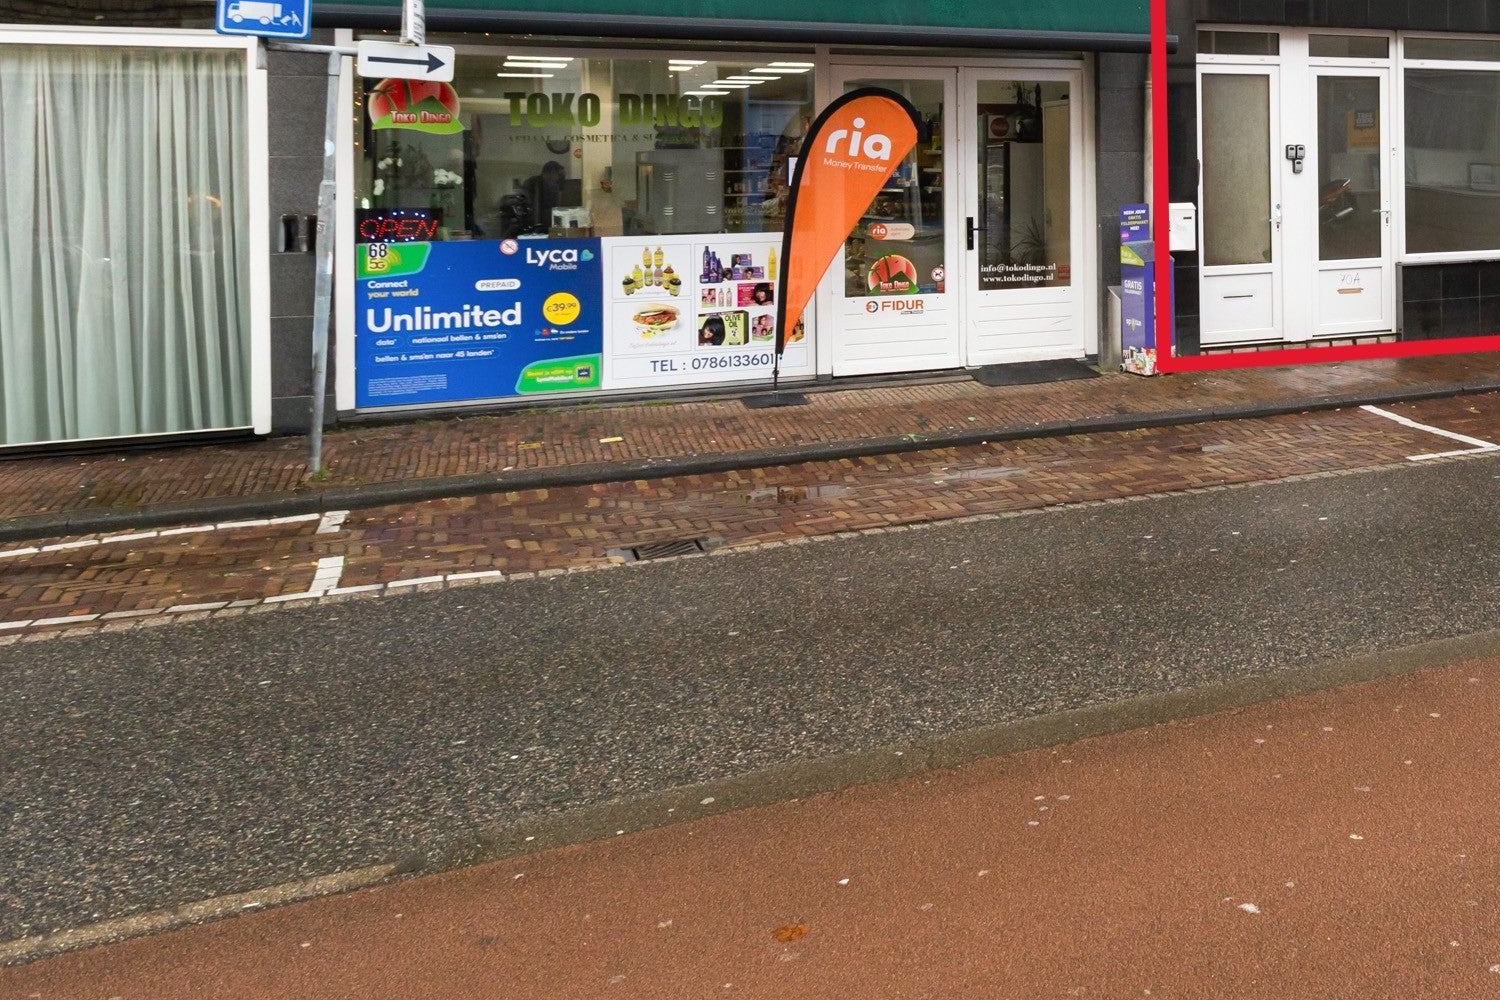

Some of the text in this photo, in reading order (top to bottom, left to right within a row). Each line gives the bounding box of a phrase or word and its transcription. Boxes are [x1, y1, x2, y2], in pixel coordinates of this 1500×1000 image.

[504, 92, 723, 128] TOKO DINGO
[826, 117, 892, 160] ria
[823, 158, 887, 172] Money Transfer
[360, 219, 438, 237] OPEN
[872, 226, 886, 234] ria
[368, 243, 387, 257] 68
[526, 247, 578, 266] Lyca
[980, 263, 1056, 272] info@tokodingo.nl
[983, 273, 1054, 283] www.tokodingo.nl
[367, 280, 408, 288] Connect
[1124, 280, 1142, 290] GRATIS
[368, 289, 419, 299] your world
[882, 300, 924, 311] FIDUR
[367, 302, 522, 332] Unlimited
[725, 314, 741, 322] OLIVE
[412, 336, 449, 344] nationaal
[375, 355, 399, 363] bellen
[650, 360, 678, 372] TEL
[692, 353, 774, 370] 0786133601
